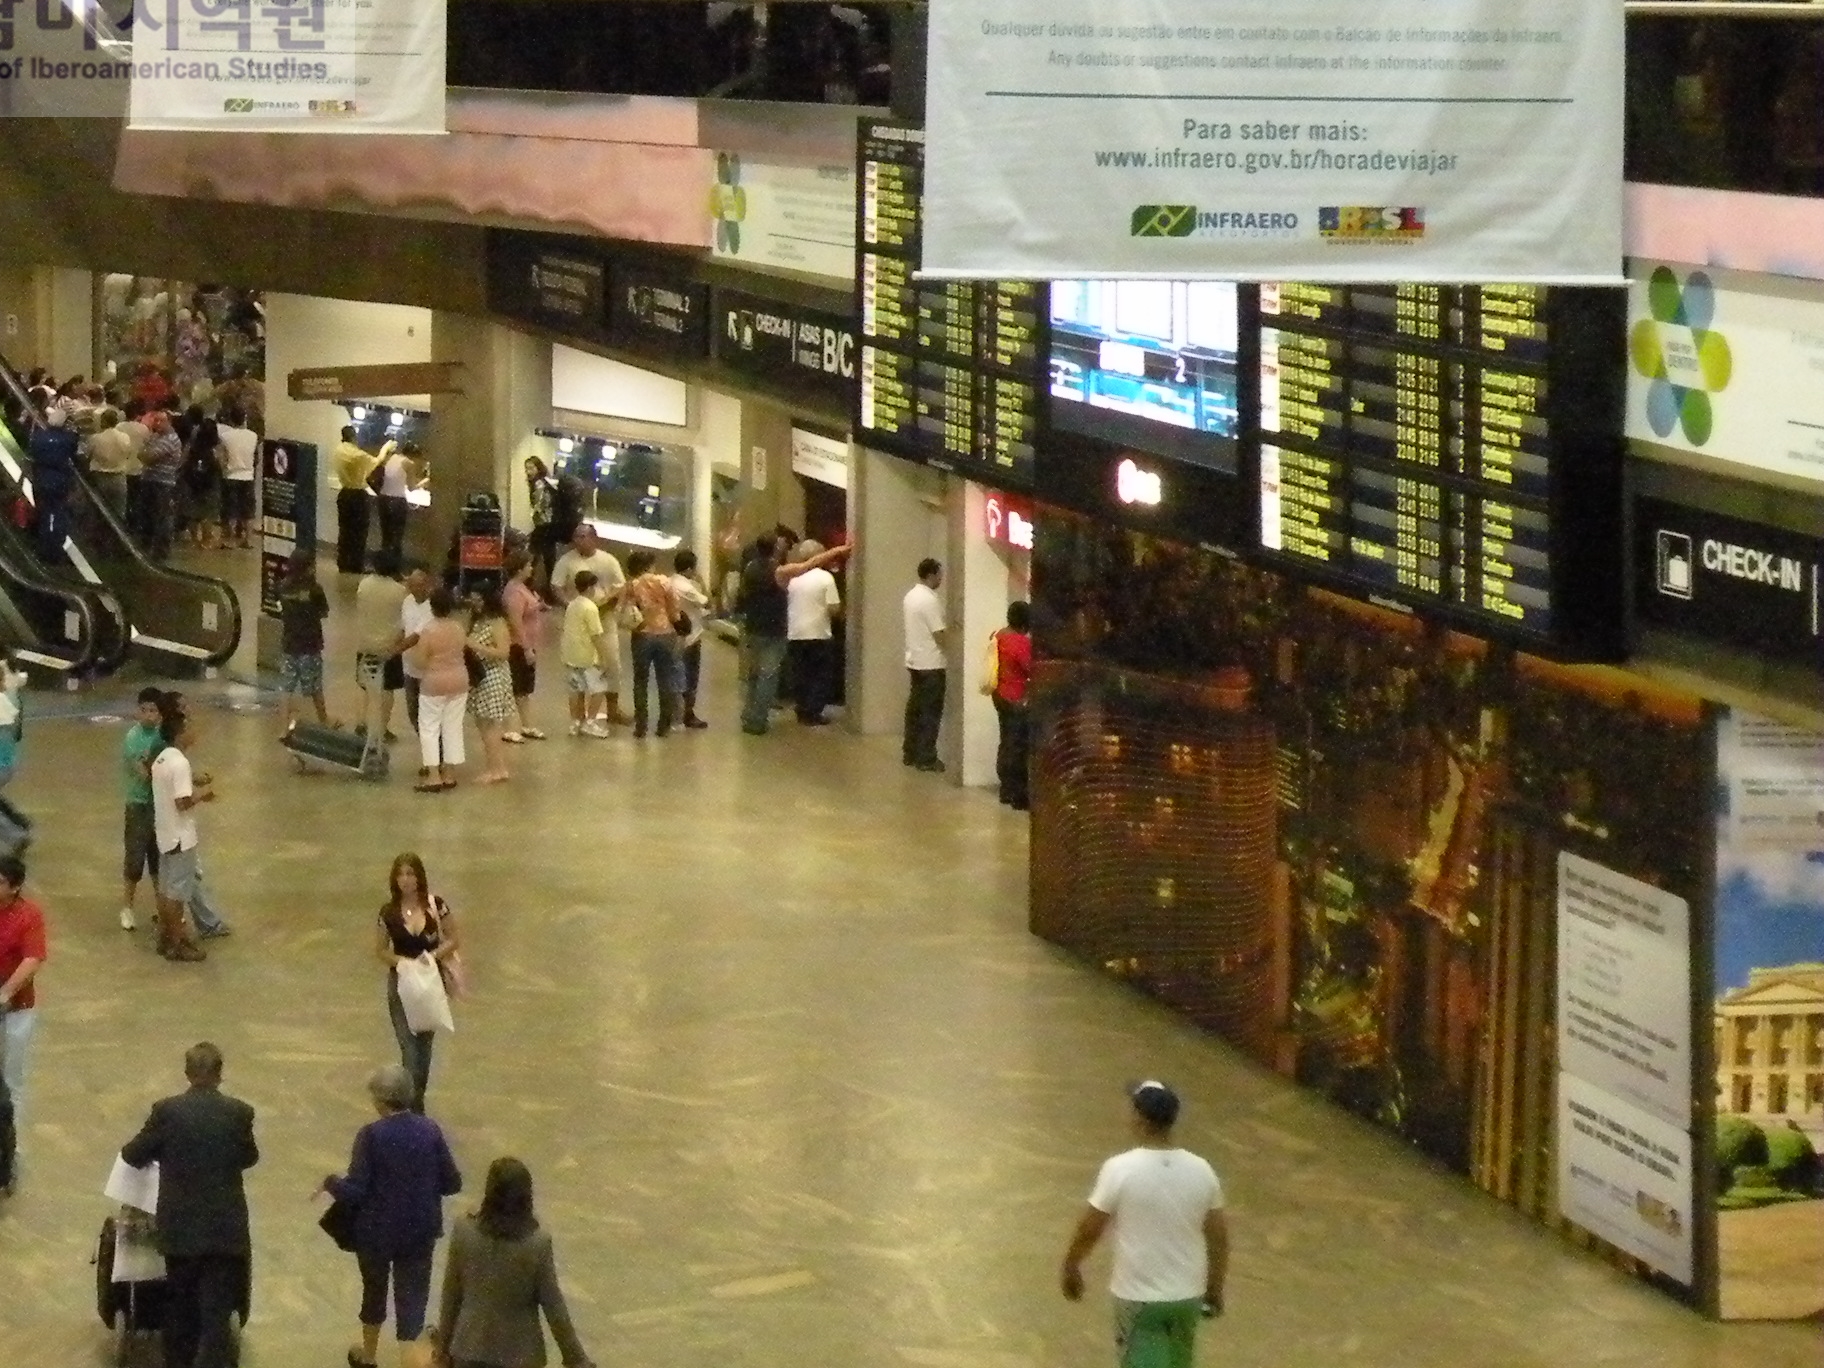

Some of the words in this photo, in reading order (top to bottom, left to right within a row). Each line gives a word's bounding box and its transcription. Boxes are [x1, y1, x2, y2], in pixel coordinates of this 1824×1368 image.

[1183, 117, 1233, 140] Para
[1239, 120, 1302, 142] saber
[1307, 122, 1368, 143] mais:
[1197, 212, 1299, 229] INFRAERO
[823, 328, 854, 379] B/C
[1702, 537, 1803, 594] CHECK-IN
